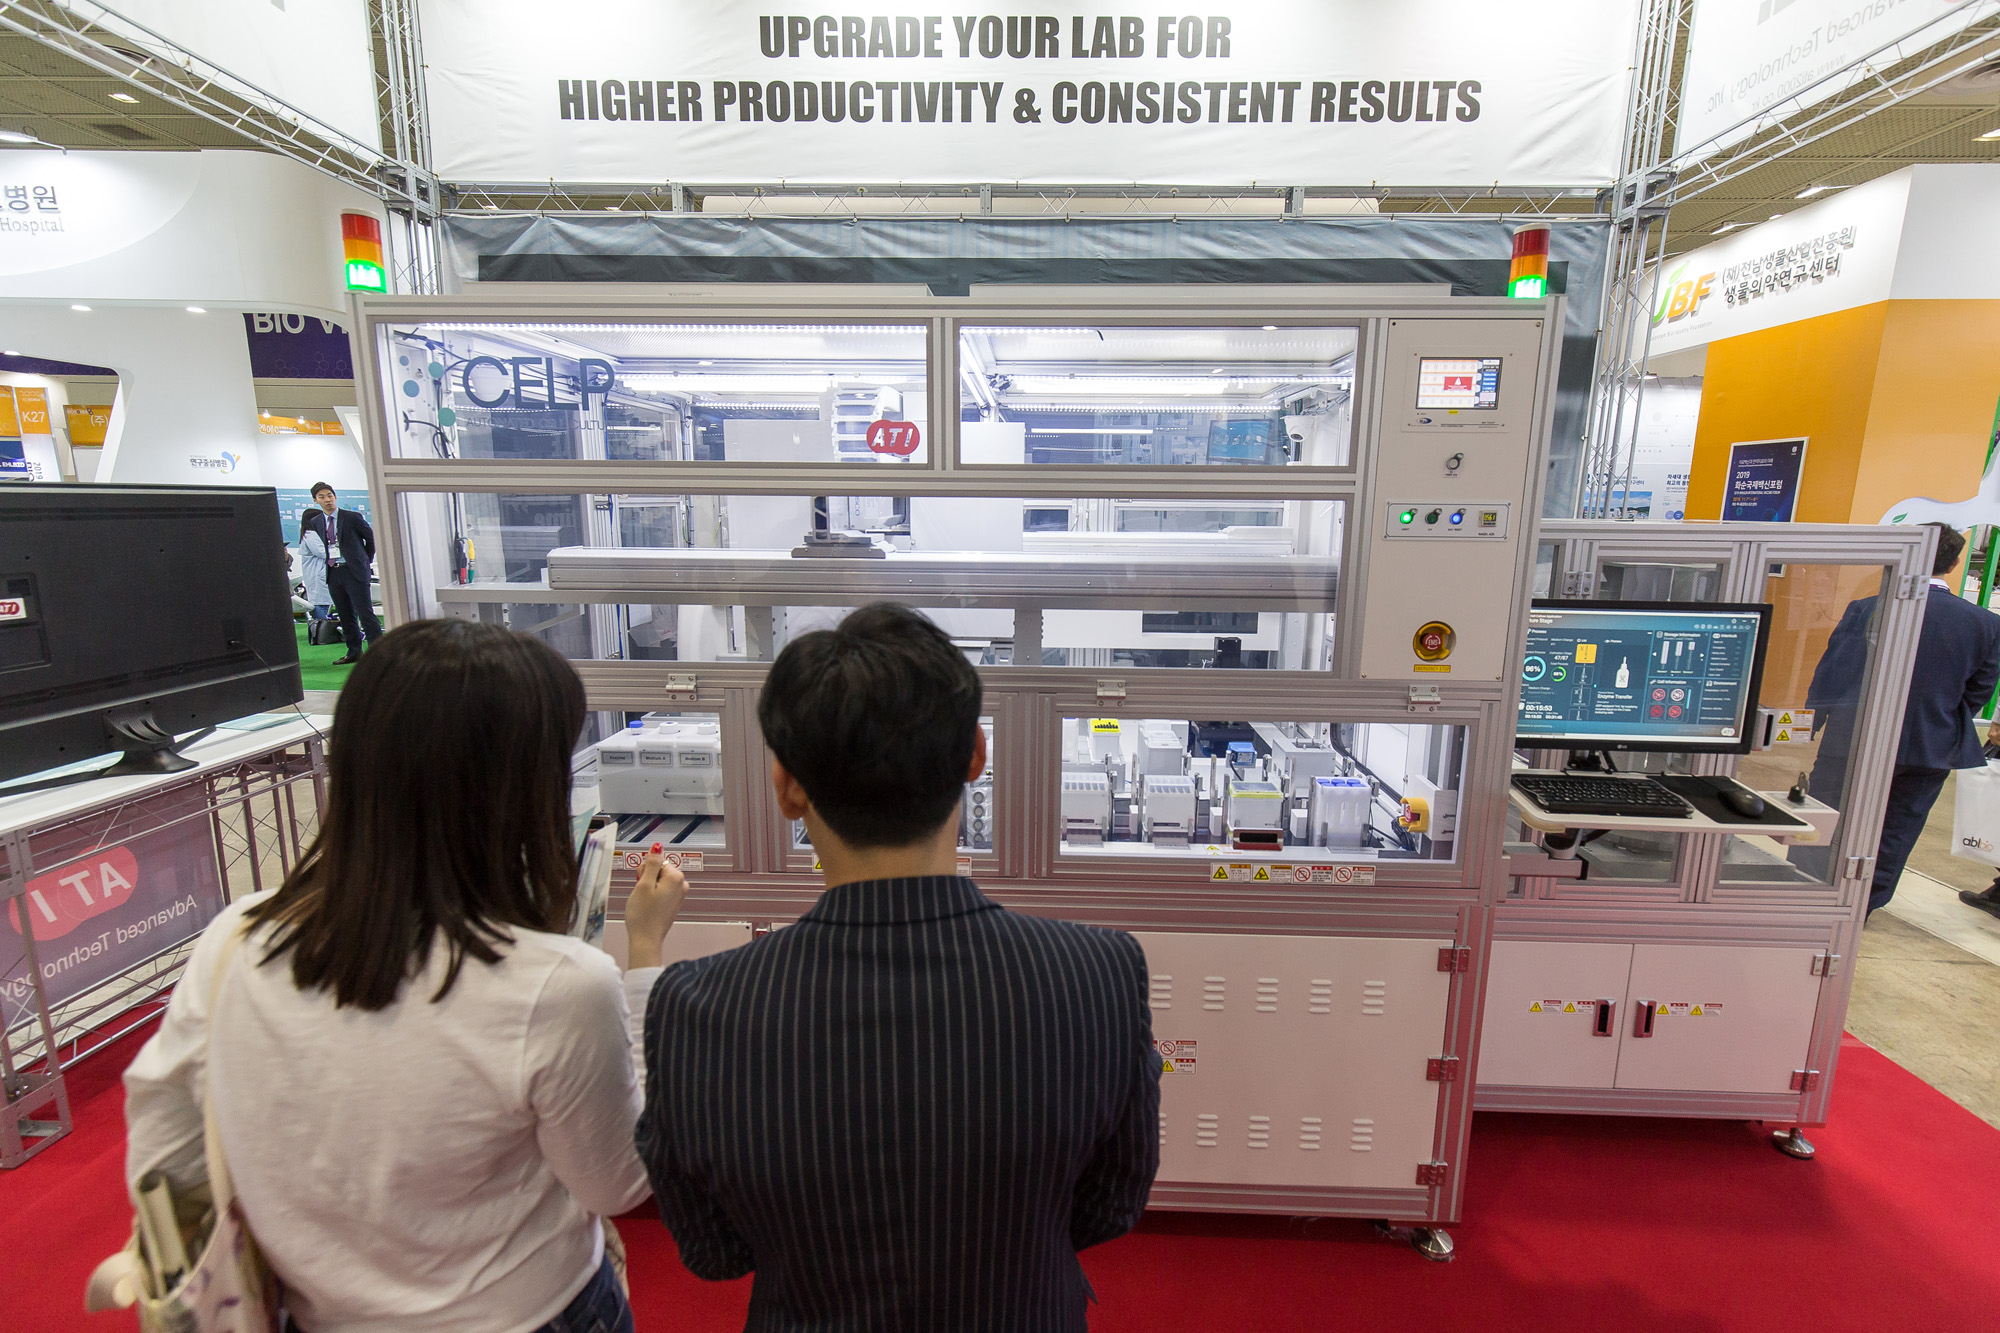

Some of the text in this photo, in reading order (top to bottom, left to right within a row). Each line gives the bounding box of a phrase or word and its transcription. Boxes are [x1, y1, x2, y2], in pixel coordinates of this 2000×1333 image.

[759, 15, 1232, 59] UPGRADE YOUR LAB FOR
[558, 79, 1482, 124] HIGHER PRODUCTIVITY & CONSISTENT RESULTS
[3, 185, 58, 211] 병원
[0, 217, 64, 236] Hospital
[1722, 225, 1854, 284] (재)전남생물산업진흥원
[1723, 253, 1841, 304] 생물의약연구센터
[253, 312, 306, 334] BIO
[463, 355, 615, 411] CELP
[22, 411, 45, 422] K27
[90, 414, 109, 427] (주)
[573, 419, 616, 431] CULTU
[870, 427, 915, 448] ATI
[33, 462, 43, 480] 2019
[190, 457, 228, 468] 연구중심병원
[1734, 480, 1783, 490] 화순국제백신포럼
[1736, 471, 1750, 479] 2019
